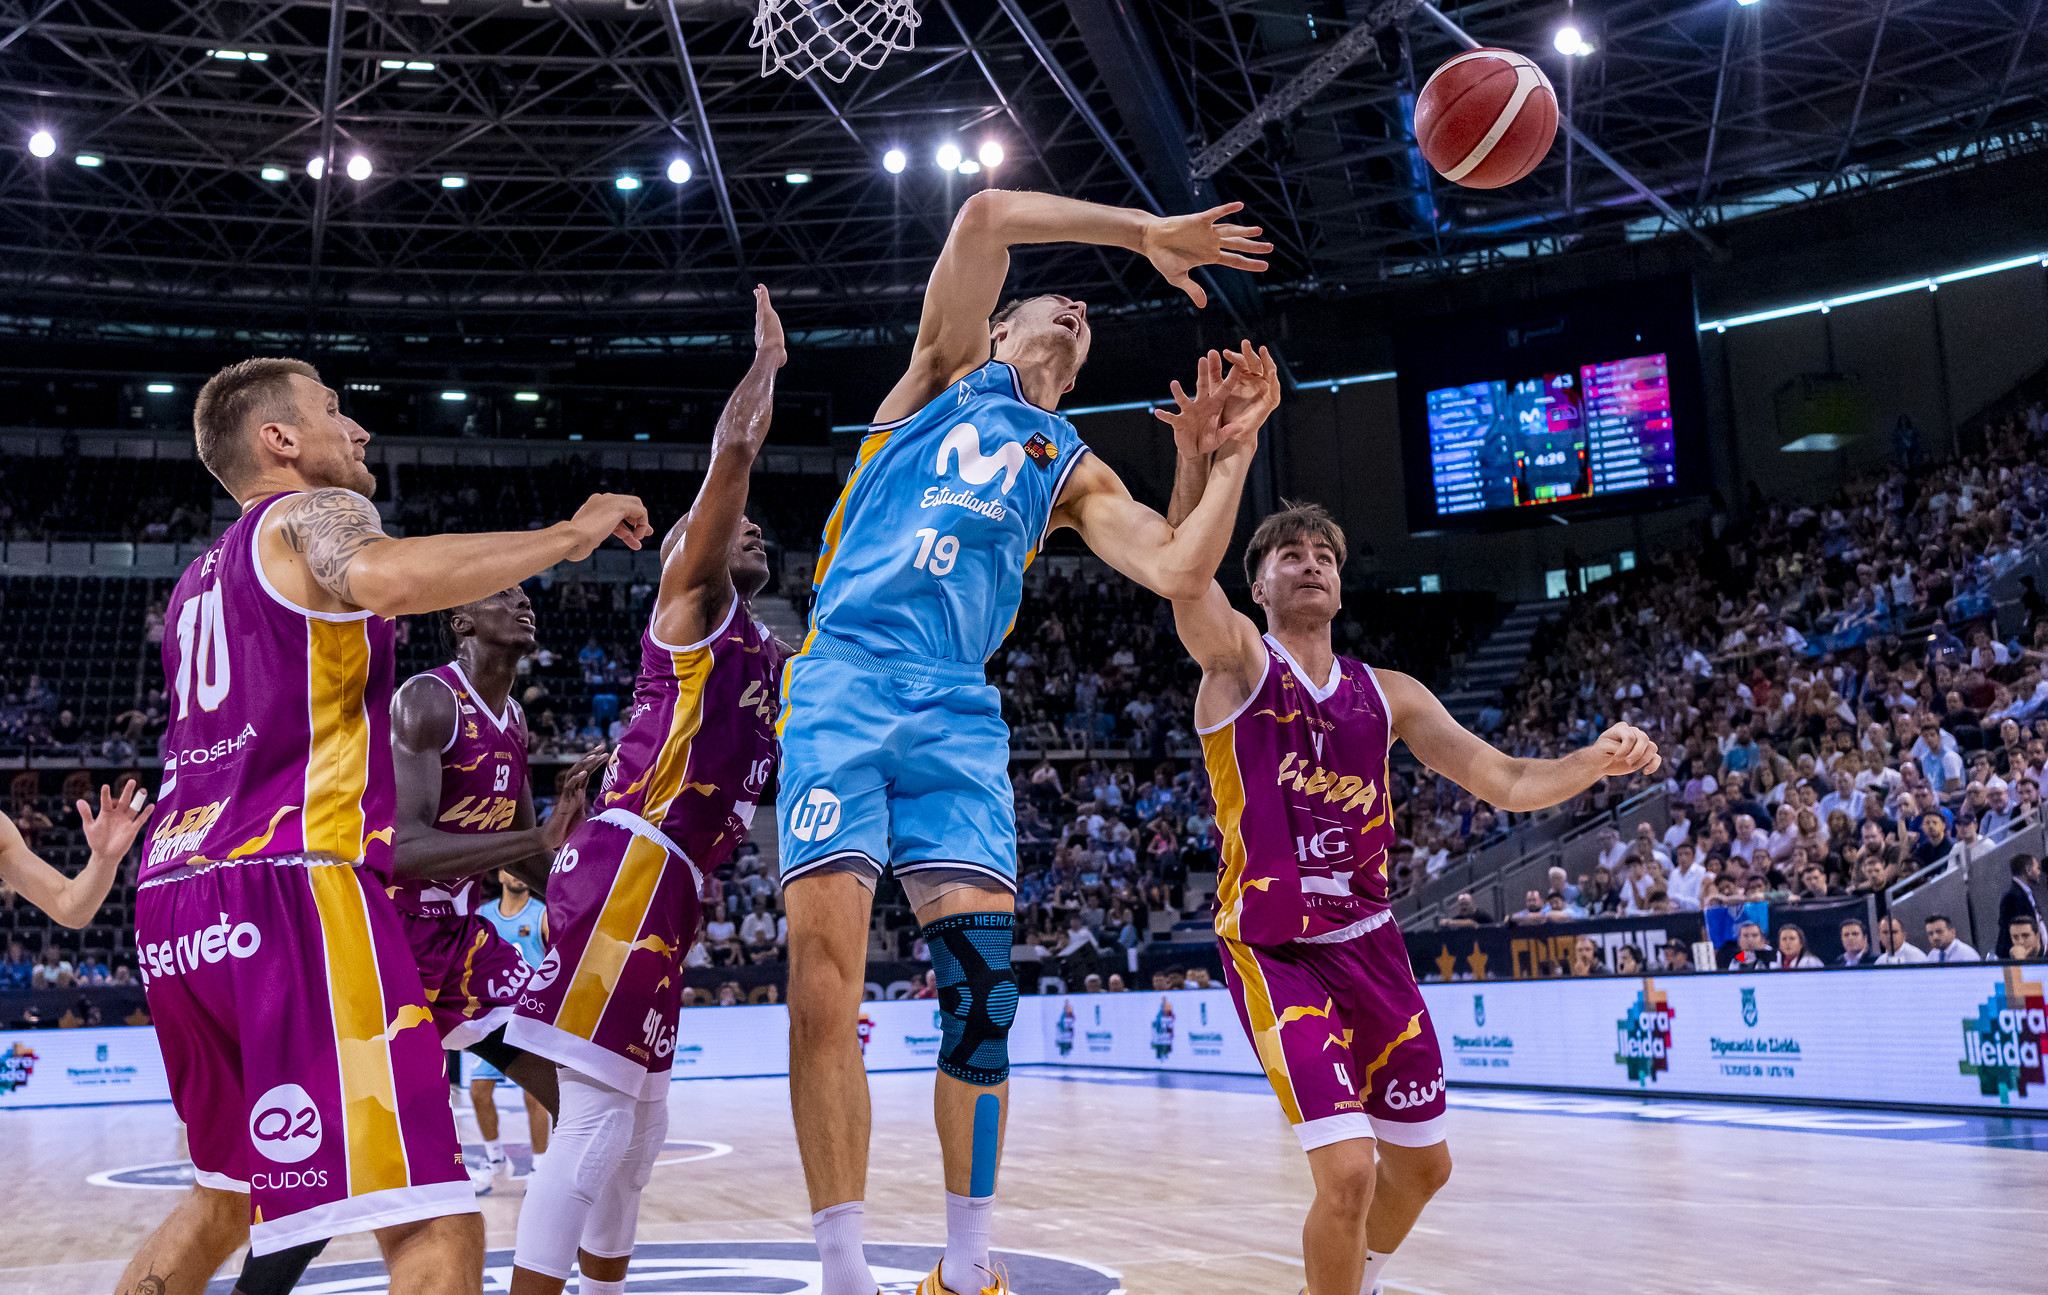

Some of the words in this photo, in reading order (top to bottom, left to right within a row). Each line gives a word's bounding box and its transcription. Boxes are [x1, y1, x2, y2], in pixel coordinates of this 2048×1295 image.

[1516, 380, 1536, 394] 14
[1552, 374, 1574, 389] 43
[1024, 446, 1040, 459] ORO
[1028, 441, 1044, 455] LEB
[920, 486, 1007, 522] Estudiantes
[913, 527, 960, 576] 19
[175, 577, 231, 721] 10
[1639, 1011, 1668, 1031] ara
[1998, 1008, 2046, 1034] ara
[1619, 1030, 1665, 1058] lleida
[1965, 1030, 2039, 1068] lleida
[1333, 1063, 1355, 1095] 4
[253, 1106, 320, 1142] Q2
[251, 1167, 329, 1190] CUDÓS
